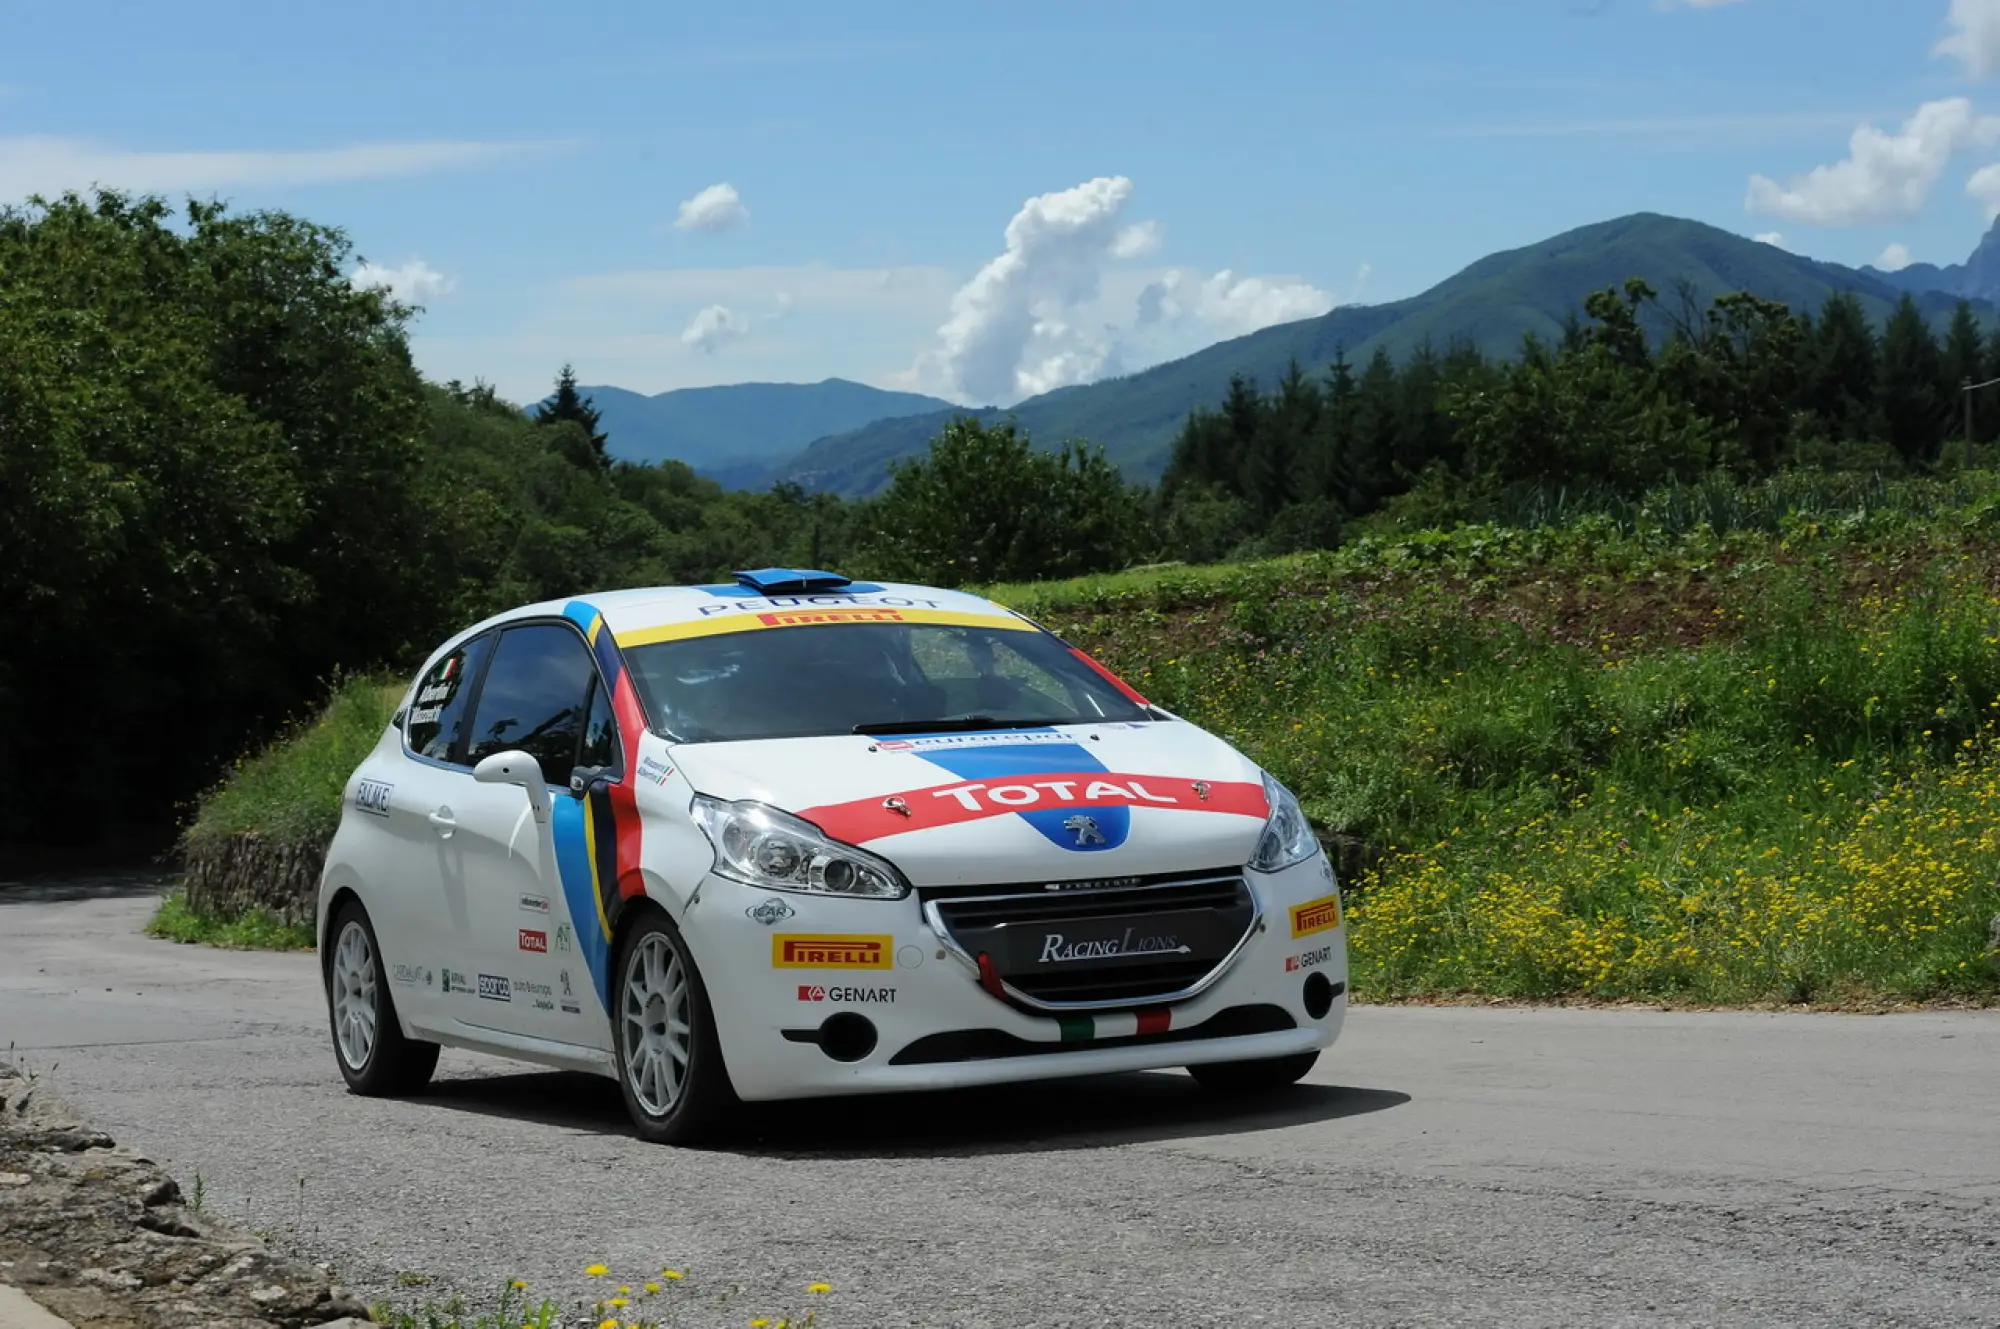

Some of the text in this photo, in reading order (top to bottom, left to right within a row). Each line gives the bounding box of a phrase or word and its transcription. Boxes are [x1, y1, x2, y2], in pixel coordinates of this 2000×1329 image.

[698, 595, 943, 617] PEUGEOT
[757, 608, 903, 626] PIRELLI
[932, 780, 1177, 811] TOTAL
[1296, 901, 1335, 931] PIRELLI
[520, 932, 546, 950] TOTAL
[783, 940, 881, 964] PIRELLI
[1301, 946, 1331, 968] GENART
[829, 986, 897, 1003] GENART
